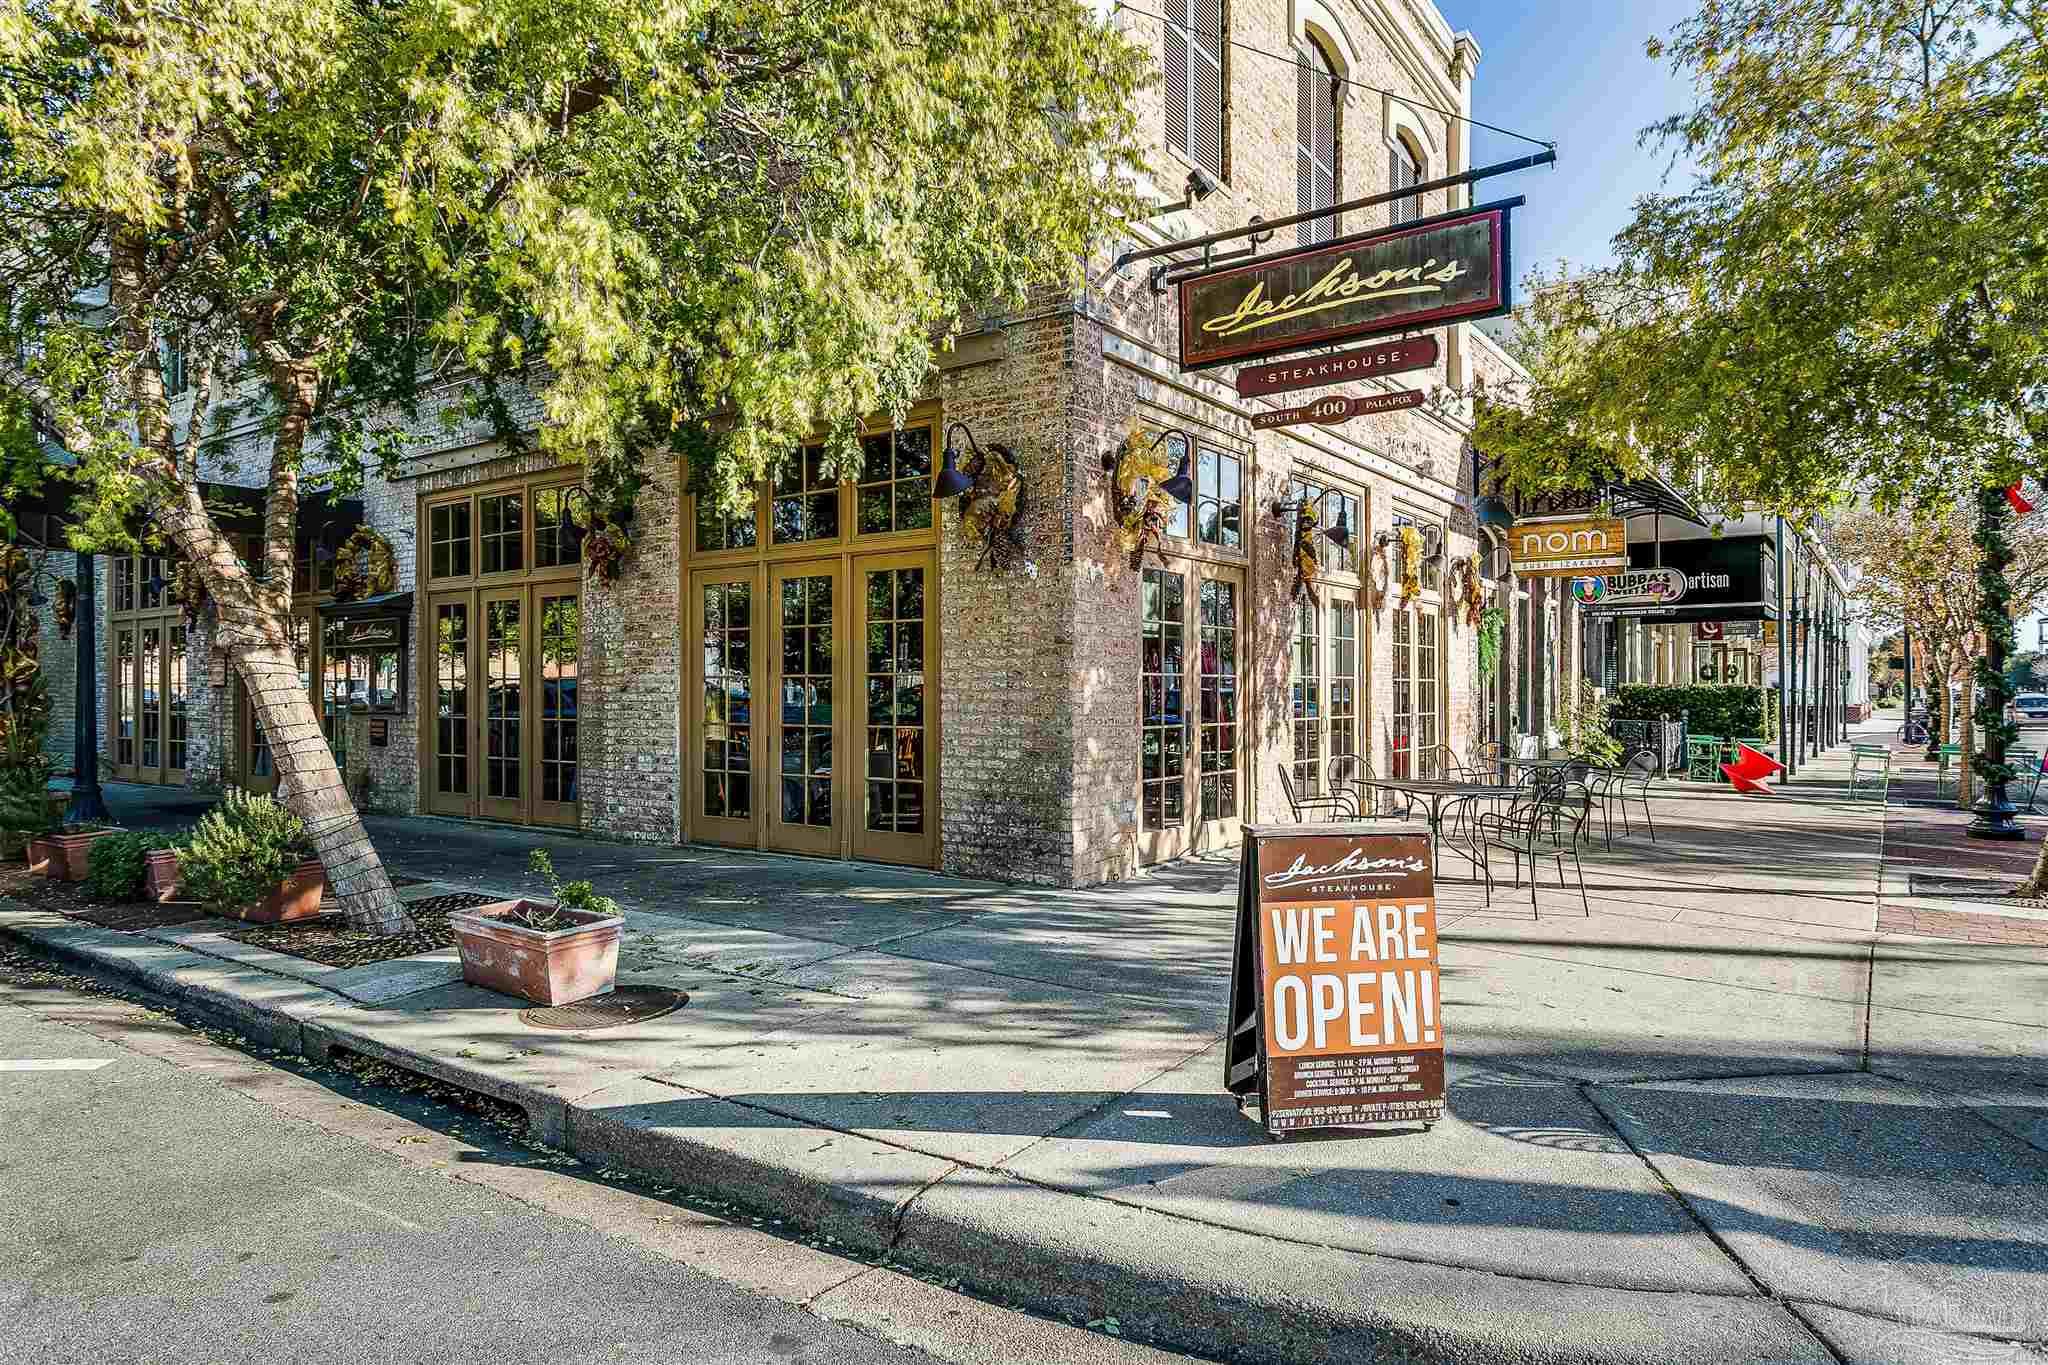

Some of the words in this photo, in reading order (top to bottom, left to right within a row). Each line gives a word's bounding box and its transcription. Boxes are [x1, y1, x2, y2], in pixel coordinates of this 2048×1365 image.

[1202, 257, 1466, 332] Jackson's
[1268, 351, 1400, 384] STEAKHOUSE
[1258, 412, 1301, 426] SOUTH
[1312, 400, 1346, 418] 400
[1365, 394, 1413, 410] PALAFOX
[1522, 529, 1608, 554] nom
[1607, 573, 1671, 589] BUBBA'S
[1688, 572, 1730, 590] artisan
[1264, 847, 1428, 883] Jackson's
[1311, 884, 1392, 893] STEAKHOUSE
[1272, 907, 1338, 964] WE
[1350, 903, 1430, 961] ARE
[1273, 969, 1437, 1051] OPEN!
